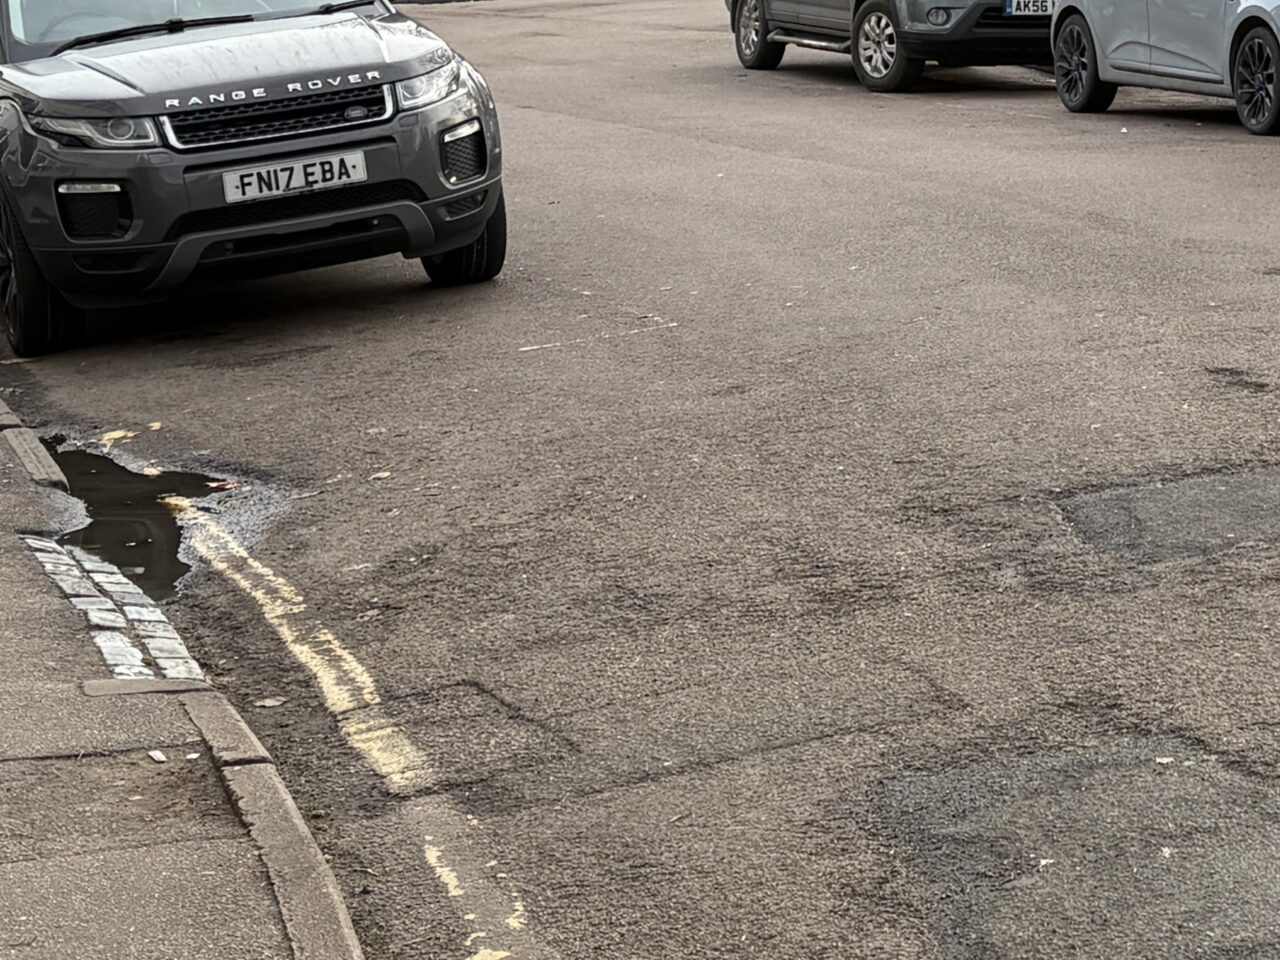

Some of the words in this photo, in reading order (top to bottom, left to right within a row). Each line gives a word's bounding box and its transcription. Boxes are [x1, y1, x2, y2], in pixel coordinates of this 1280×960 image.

[1015, 0, 1048, 13] AK56
[165, 88, 266, 108] RANGE
[287, 71, 381, 92] ROVER
[239, 167, 295, 196] FN17
[303, 158, 351, 187] EBA
